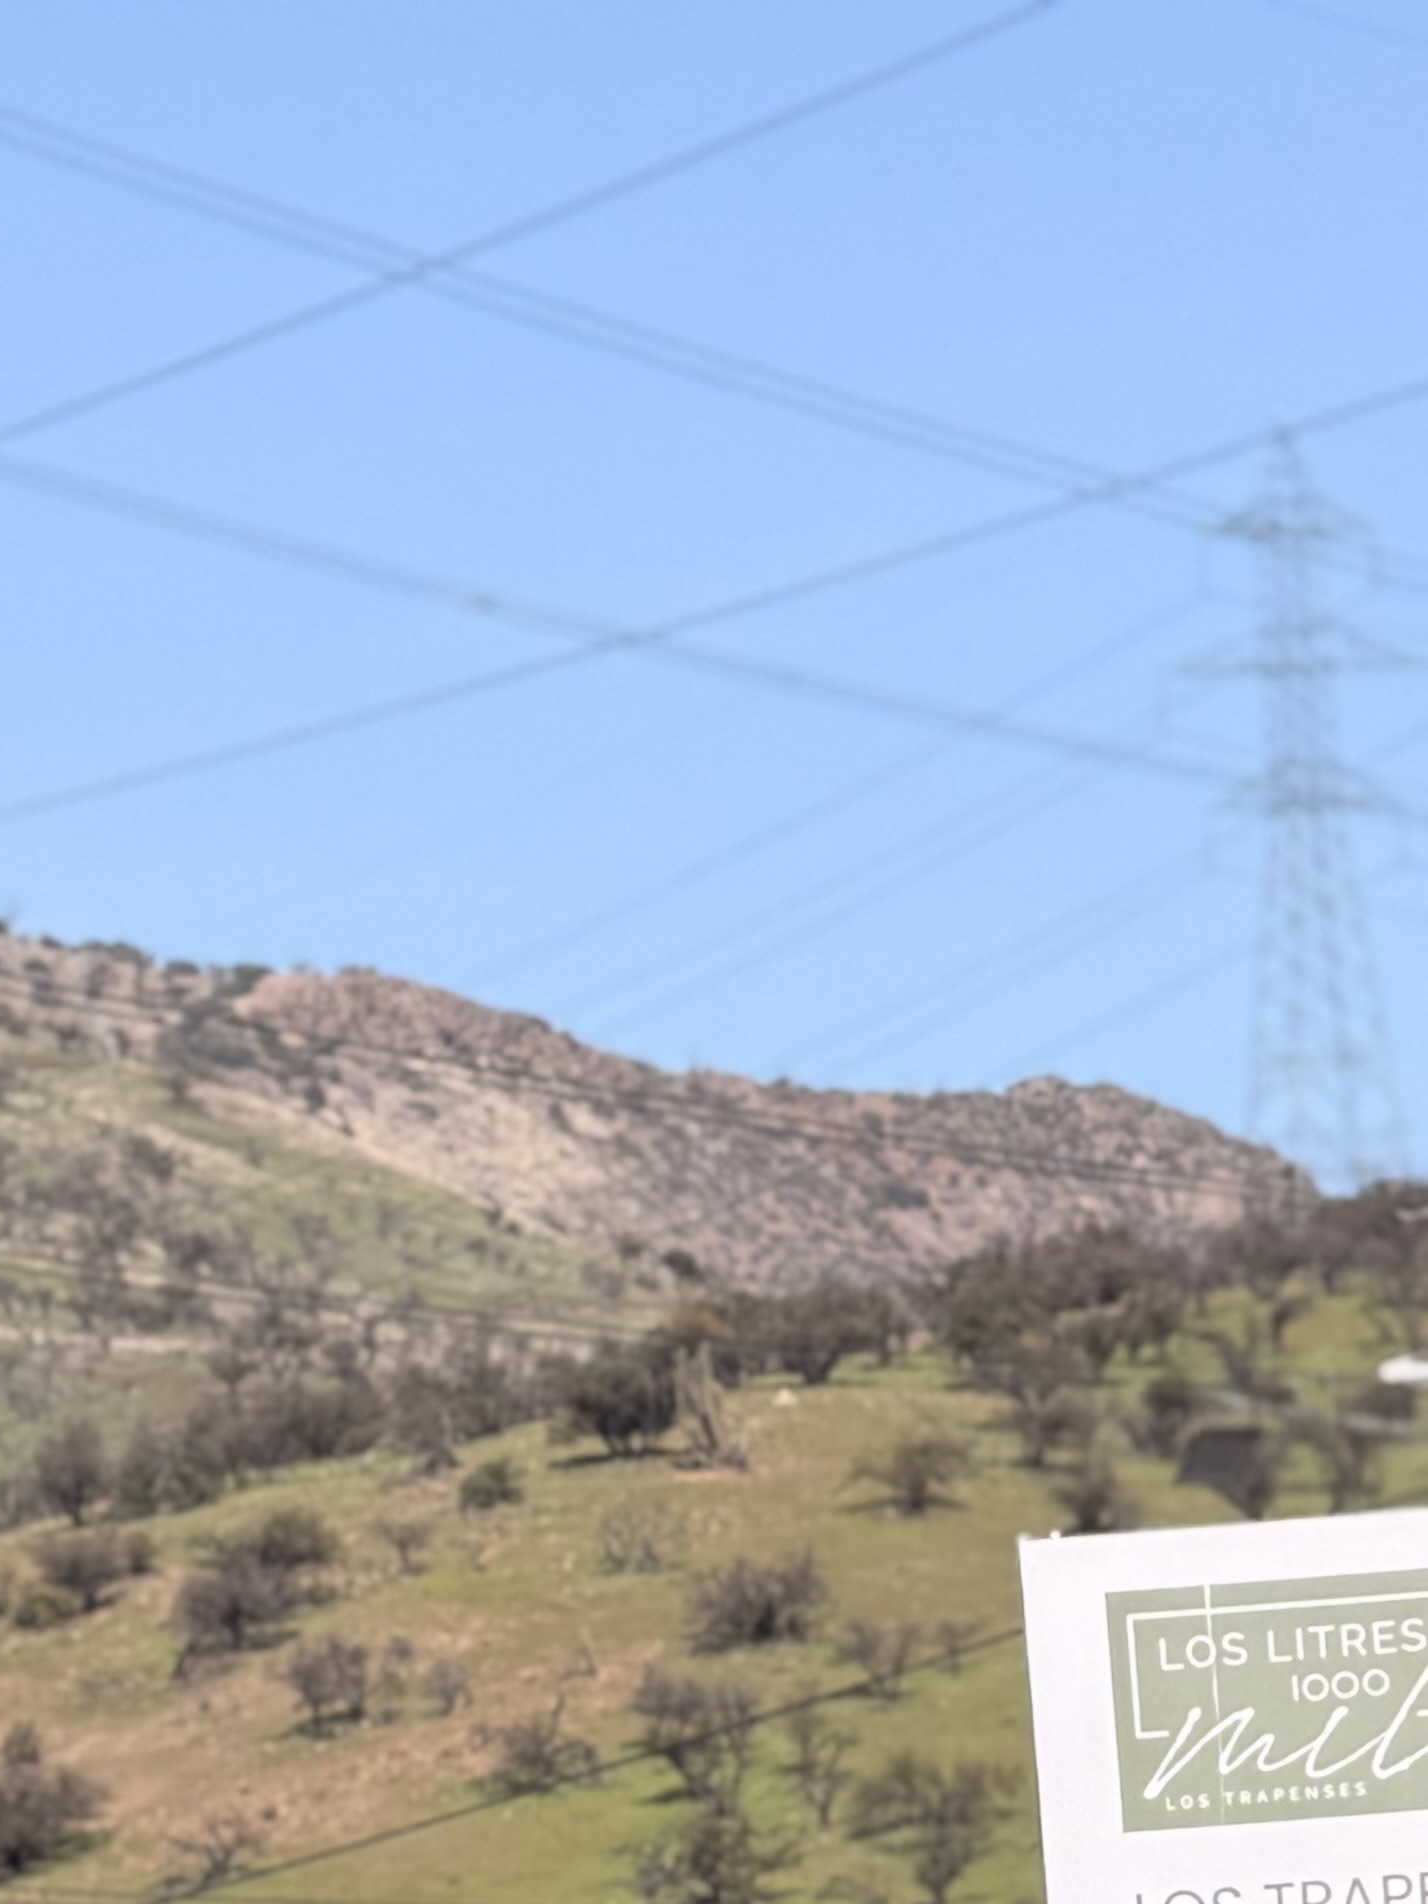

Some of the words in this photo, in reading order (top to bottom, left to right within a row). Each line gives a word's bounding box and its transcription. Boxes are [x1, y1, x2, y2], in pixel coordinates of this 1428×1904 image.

[1158, 1631, 1249, 1672] LOS
[1266, 1617, 1428, 1663] LITRES
[1291, 1667, 1391, 1702] 1000
[1164, 1793, 1210, 1812] LOS
[1223, 1780, 1368, 1807] TRAPENSES
